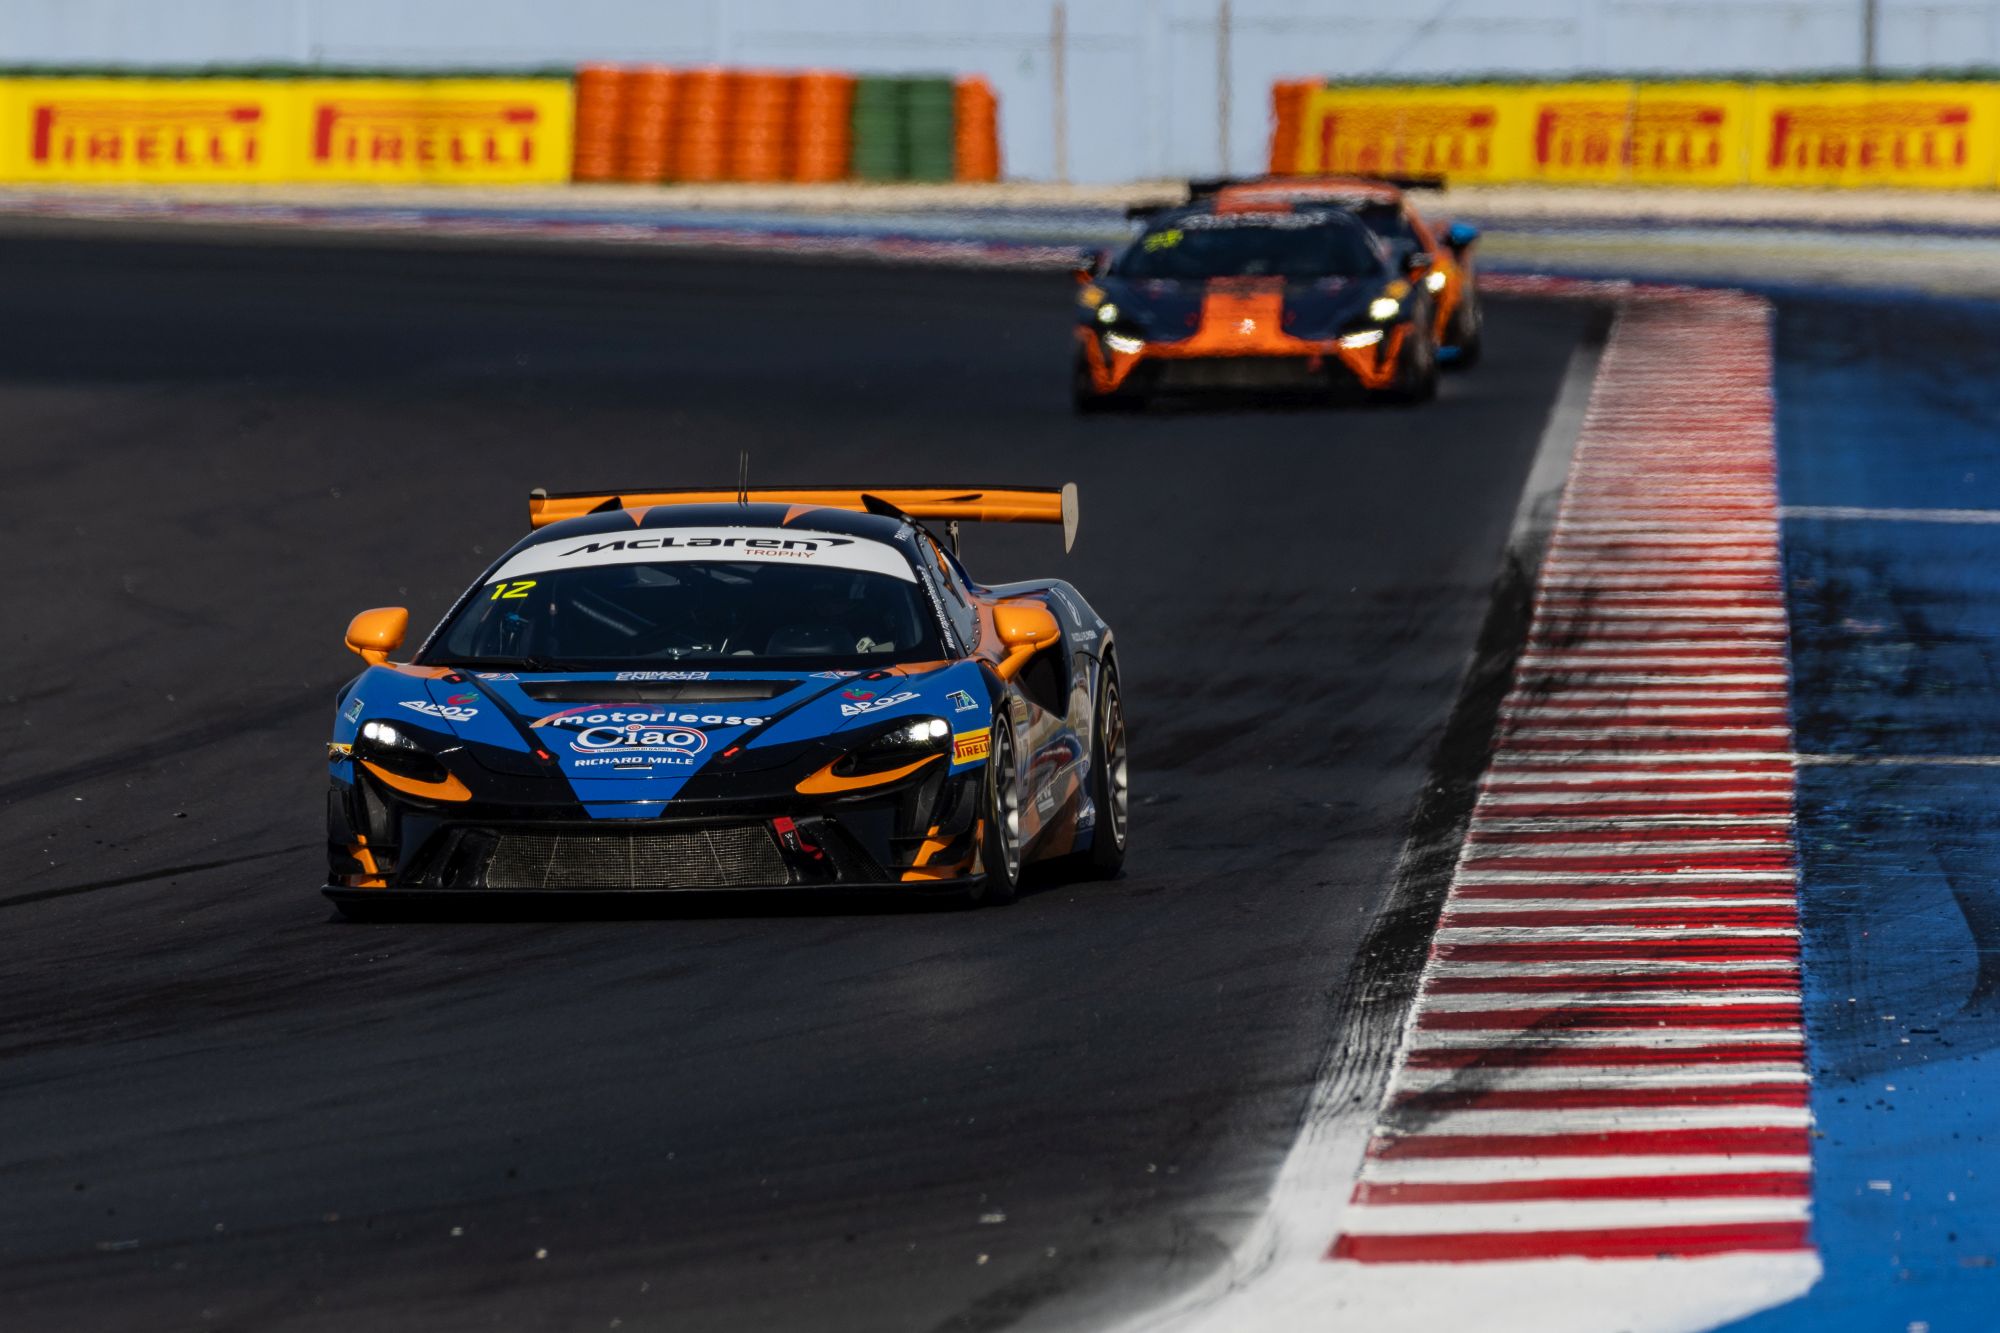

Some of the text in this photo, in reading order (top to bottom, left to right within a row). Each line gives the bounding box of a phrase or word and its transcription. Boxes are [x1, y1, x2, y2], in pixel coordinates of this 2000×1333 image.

[33, 103, 262, 163] PIRELLI
[312, 103, 540, 164] PIRELLI
[1320, 107, 1495, 171] PIRELLI
[1535, 103, 1727, 168] PIRELLI
[1768, 103, 1972, 168] PIRELLI
[558, 537, 818, 557] McLaren
[744, 549, 815, 558] TROPHY
[491, 581, 537, 600] 12
[553, 711, 764, 726] motorlease
[577, 724, 696, 749] Ciao
[575, 756, 694, 767] RICHARD MILLE
